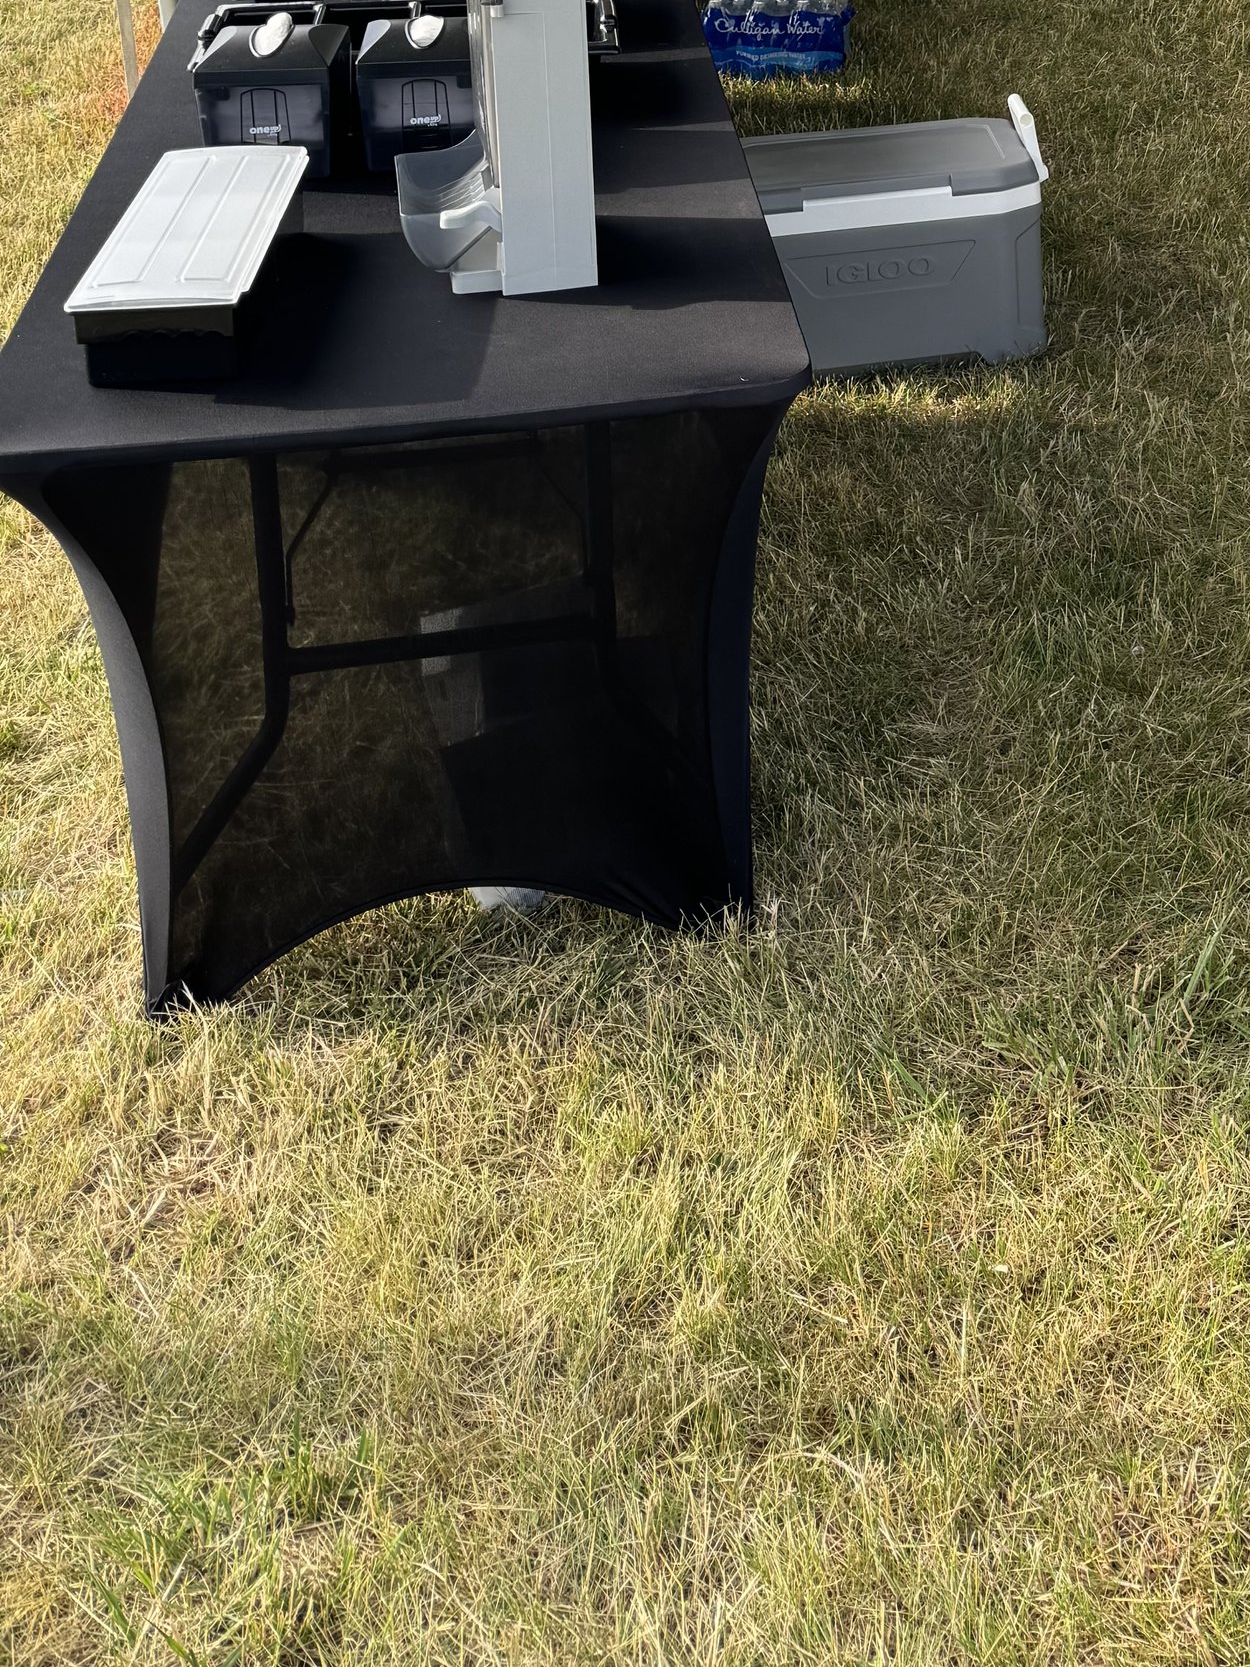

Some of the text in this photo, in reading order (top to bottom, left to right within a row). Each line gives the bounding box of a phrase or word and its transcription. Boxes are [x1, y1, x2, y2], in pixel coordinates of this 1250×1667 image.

[714, 18, 824, 41] Culligan Water
[825, 255, 937, 287] IGLOO
